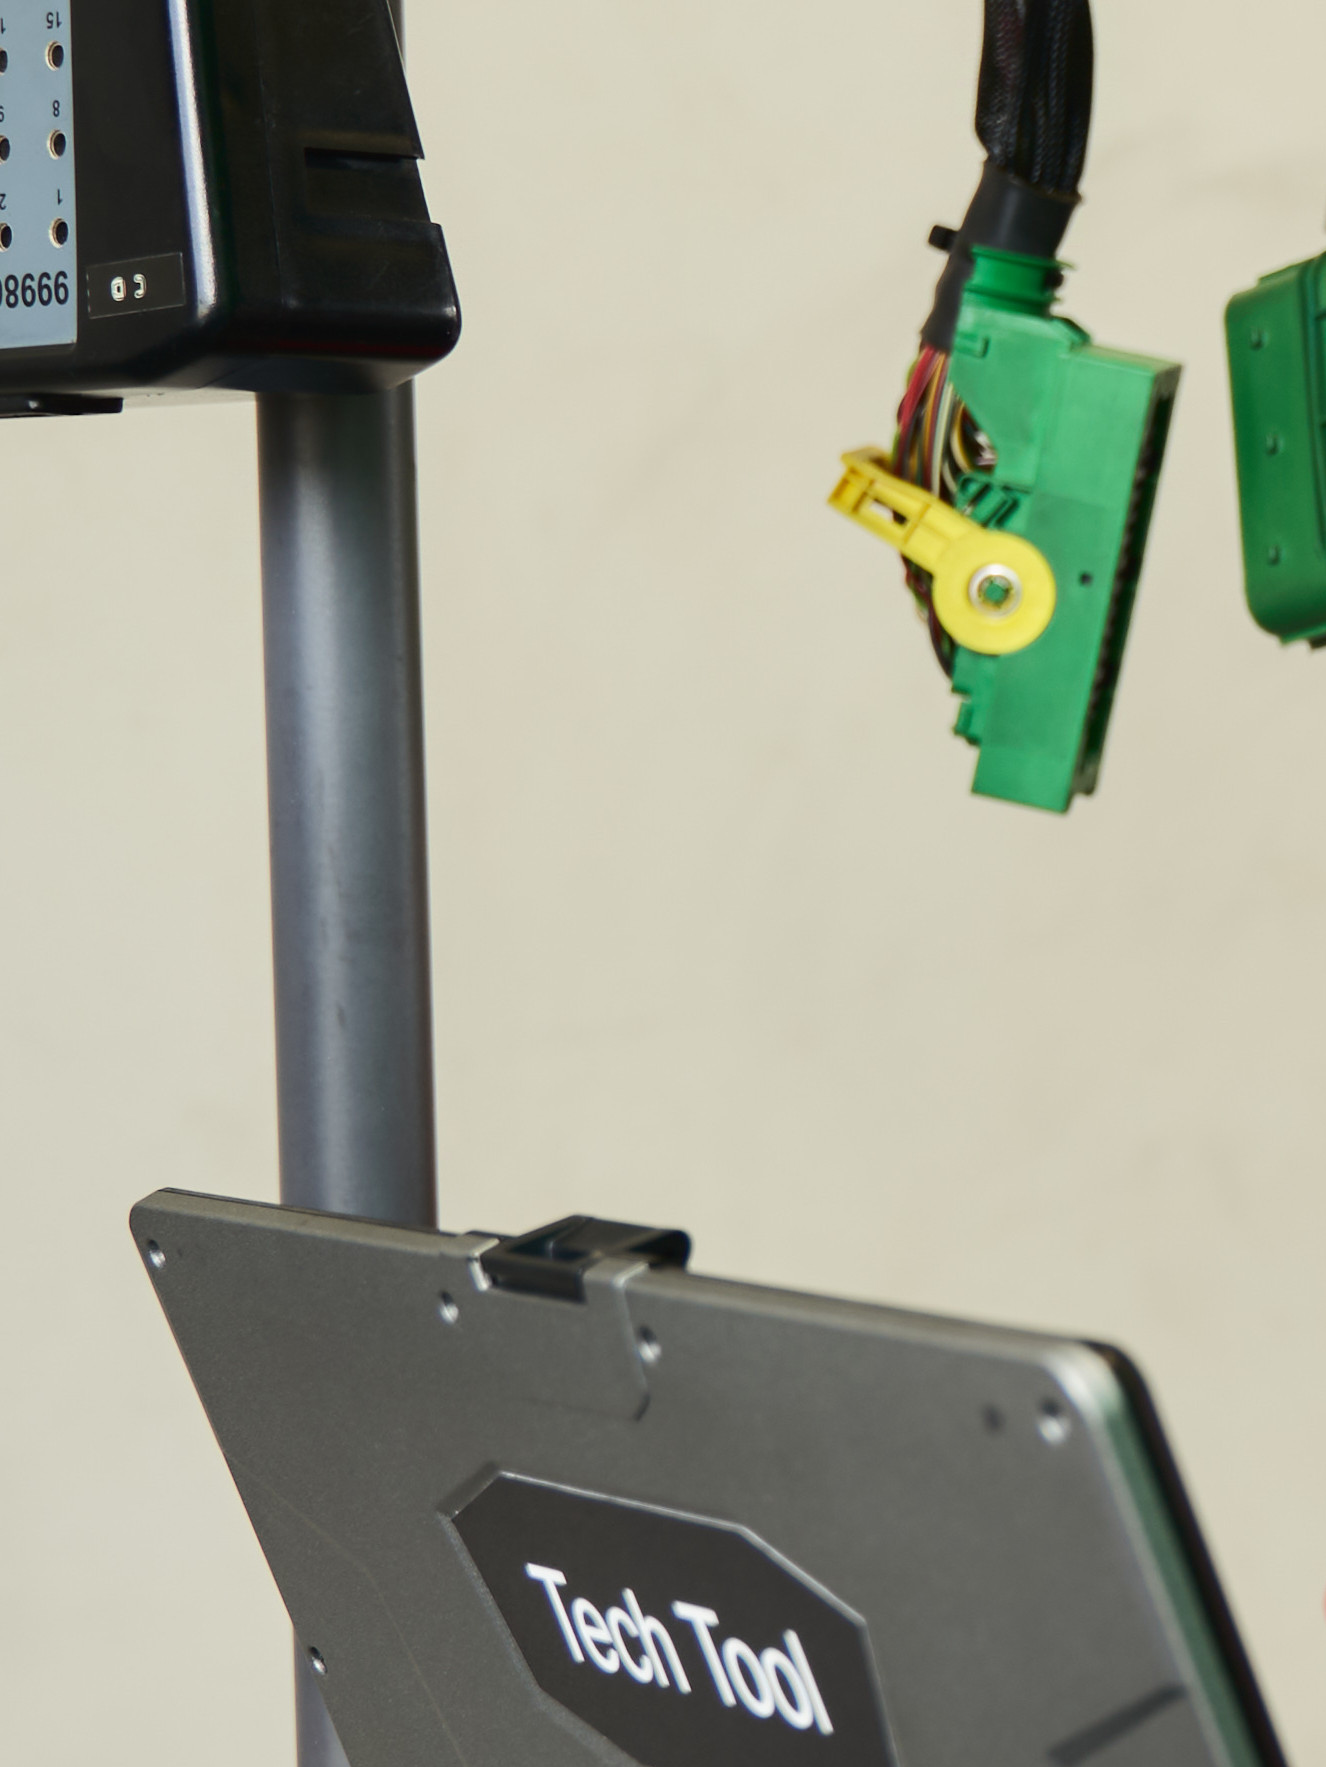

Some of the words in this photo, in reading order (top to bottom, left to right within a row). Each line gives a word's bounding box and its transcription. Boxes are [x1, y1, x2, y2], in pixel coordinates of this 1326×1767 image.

[46, 11, 62, 29] 15
[52, 100, 60, 118] 8
[56, 189, 63, 206] 1
[0, 271, 69, 309] 9998
[526, 1562, 691, 1694] Tech
[672, 1600, 834, 1734] Tool
